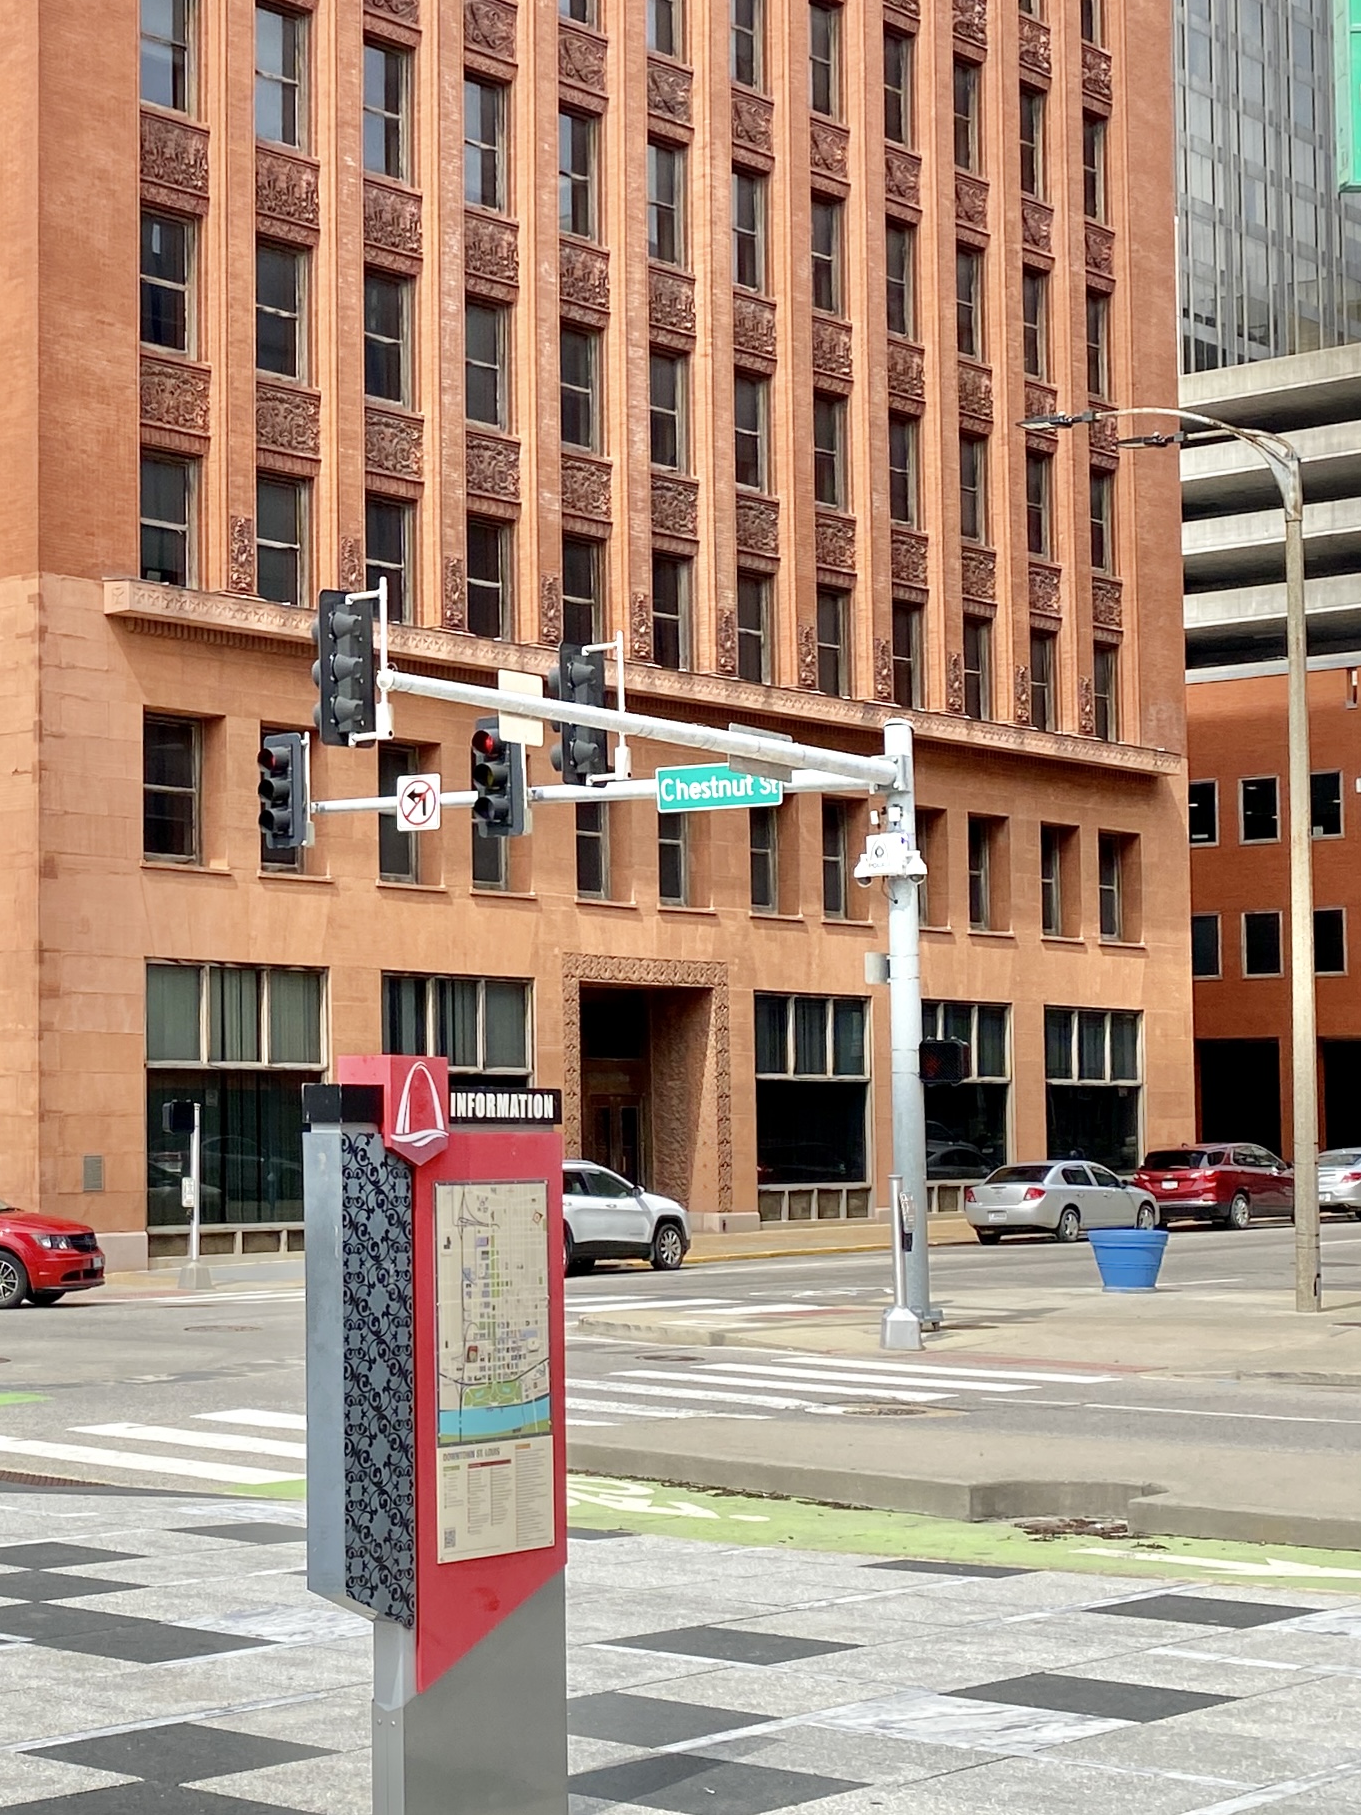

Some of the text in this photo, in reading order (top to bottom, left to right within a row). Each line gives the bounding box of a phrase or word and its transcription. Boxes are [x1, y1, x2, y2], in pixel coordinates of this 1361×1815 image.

[660, 774, 778, 802] Chestnut St
[450, 1092, 554, 1119] INFORMATION
